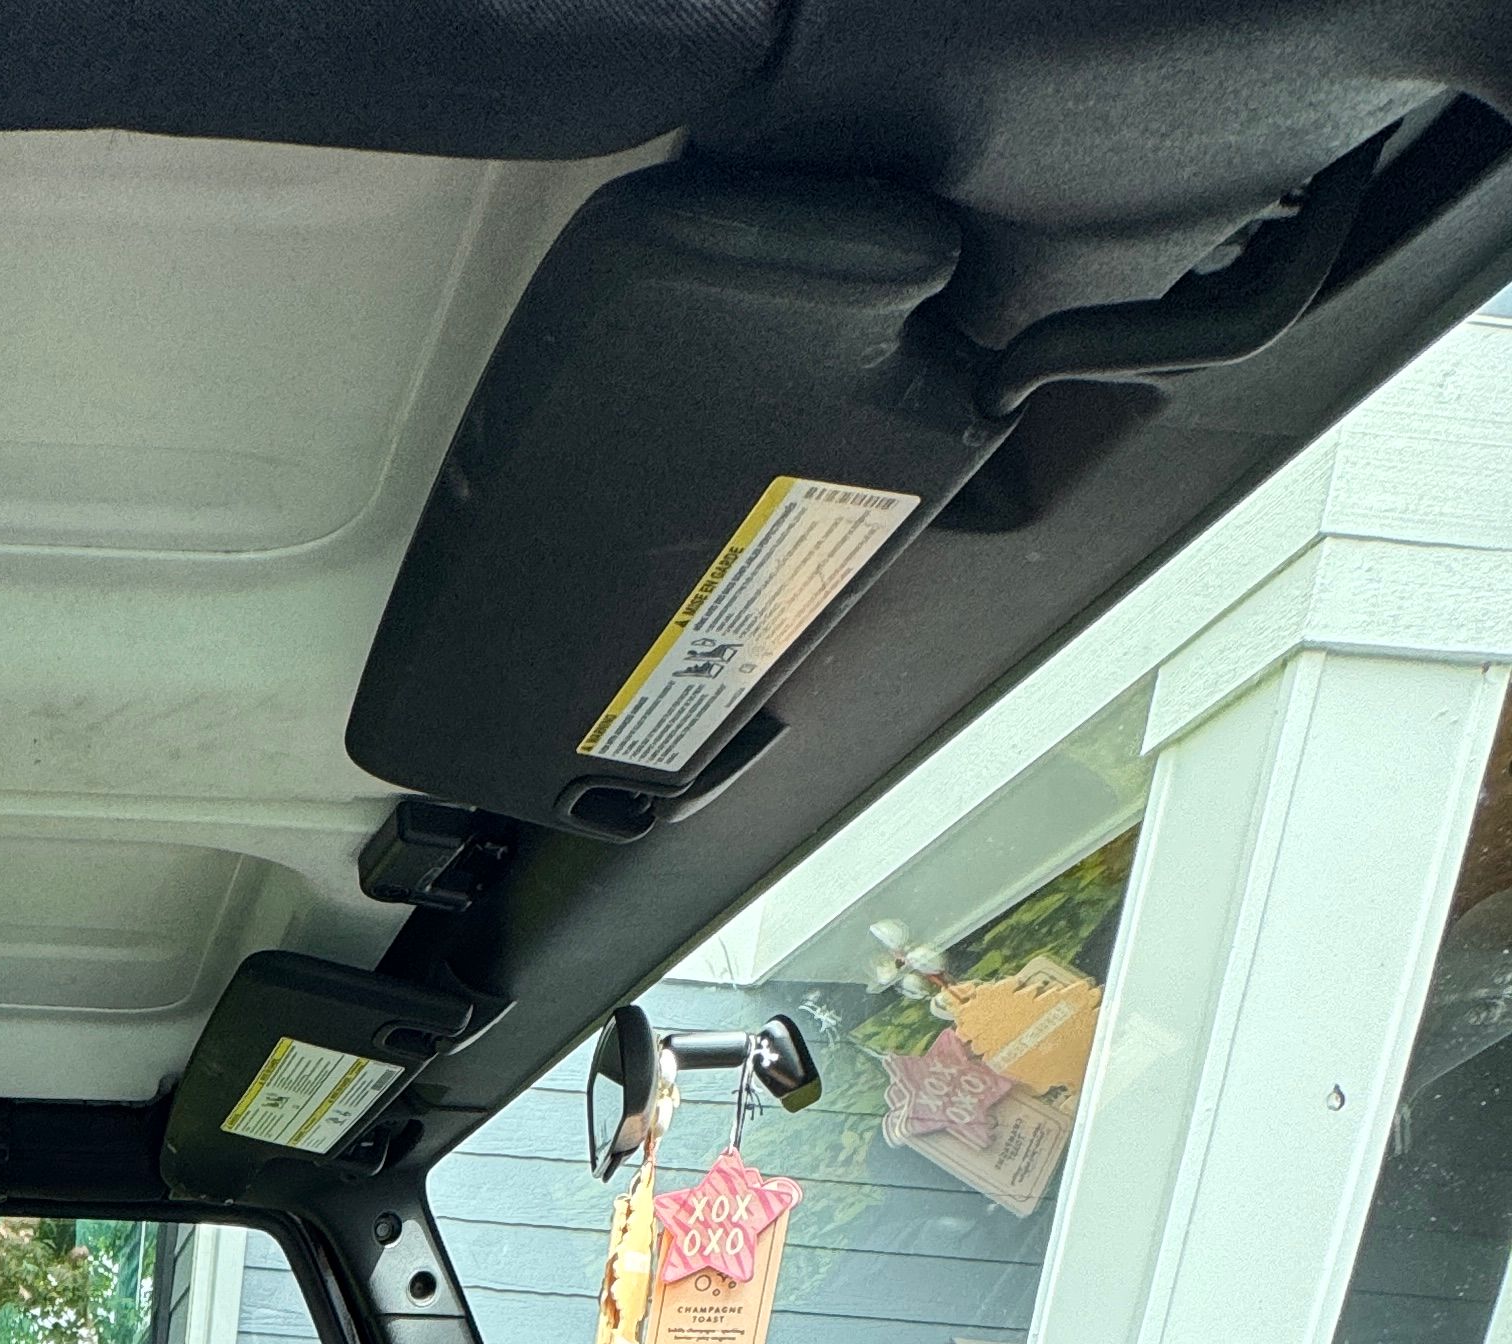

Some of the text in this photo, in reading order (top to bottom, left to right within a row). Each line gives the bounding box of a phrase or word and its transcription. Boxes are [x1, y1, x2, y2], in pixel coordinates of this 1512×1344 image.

[682, 591, 704, 618] MISE
[711, 546, 744, 587] GARDE
[687, 1194, 752, 1225] XOX
[683, 1228, 744, 1256] OXO
[677, 1306, 743, 1314] CHAMPAGNE
[692, 1315, 724, 1323] TOAST
